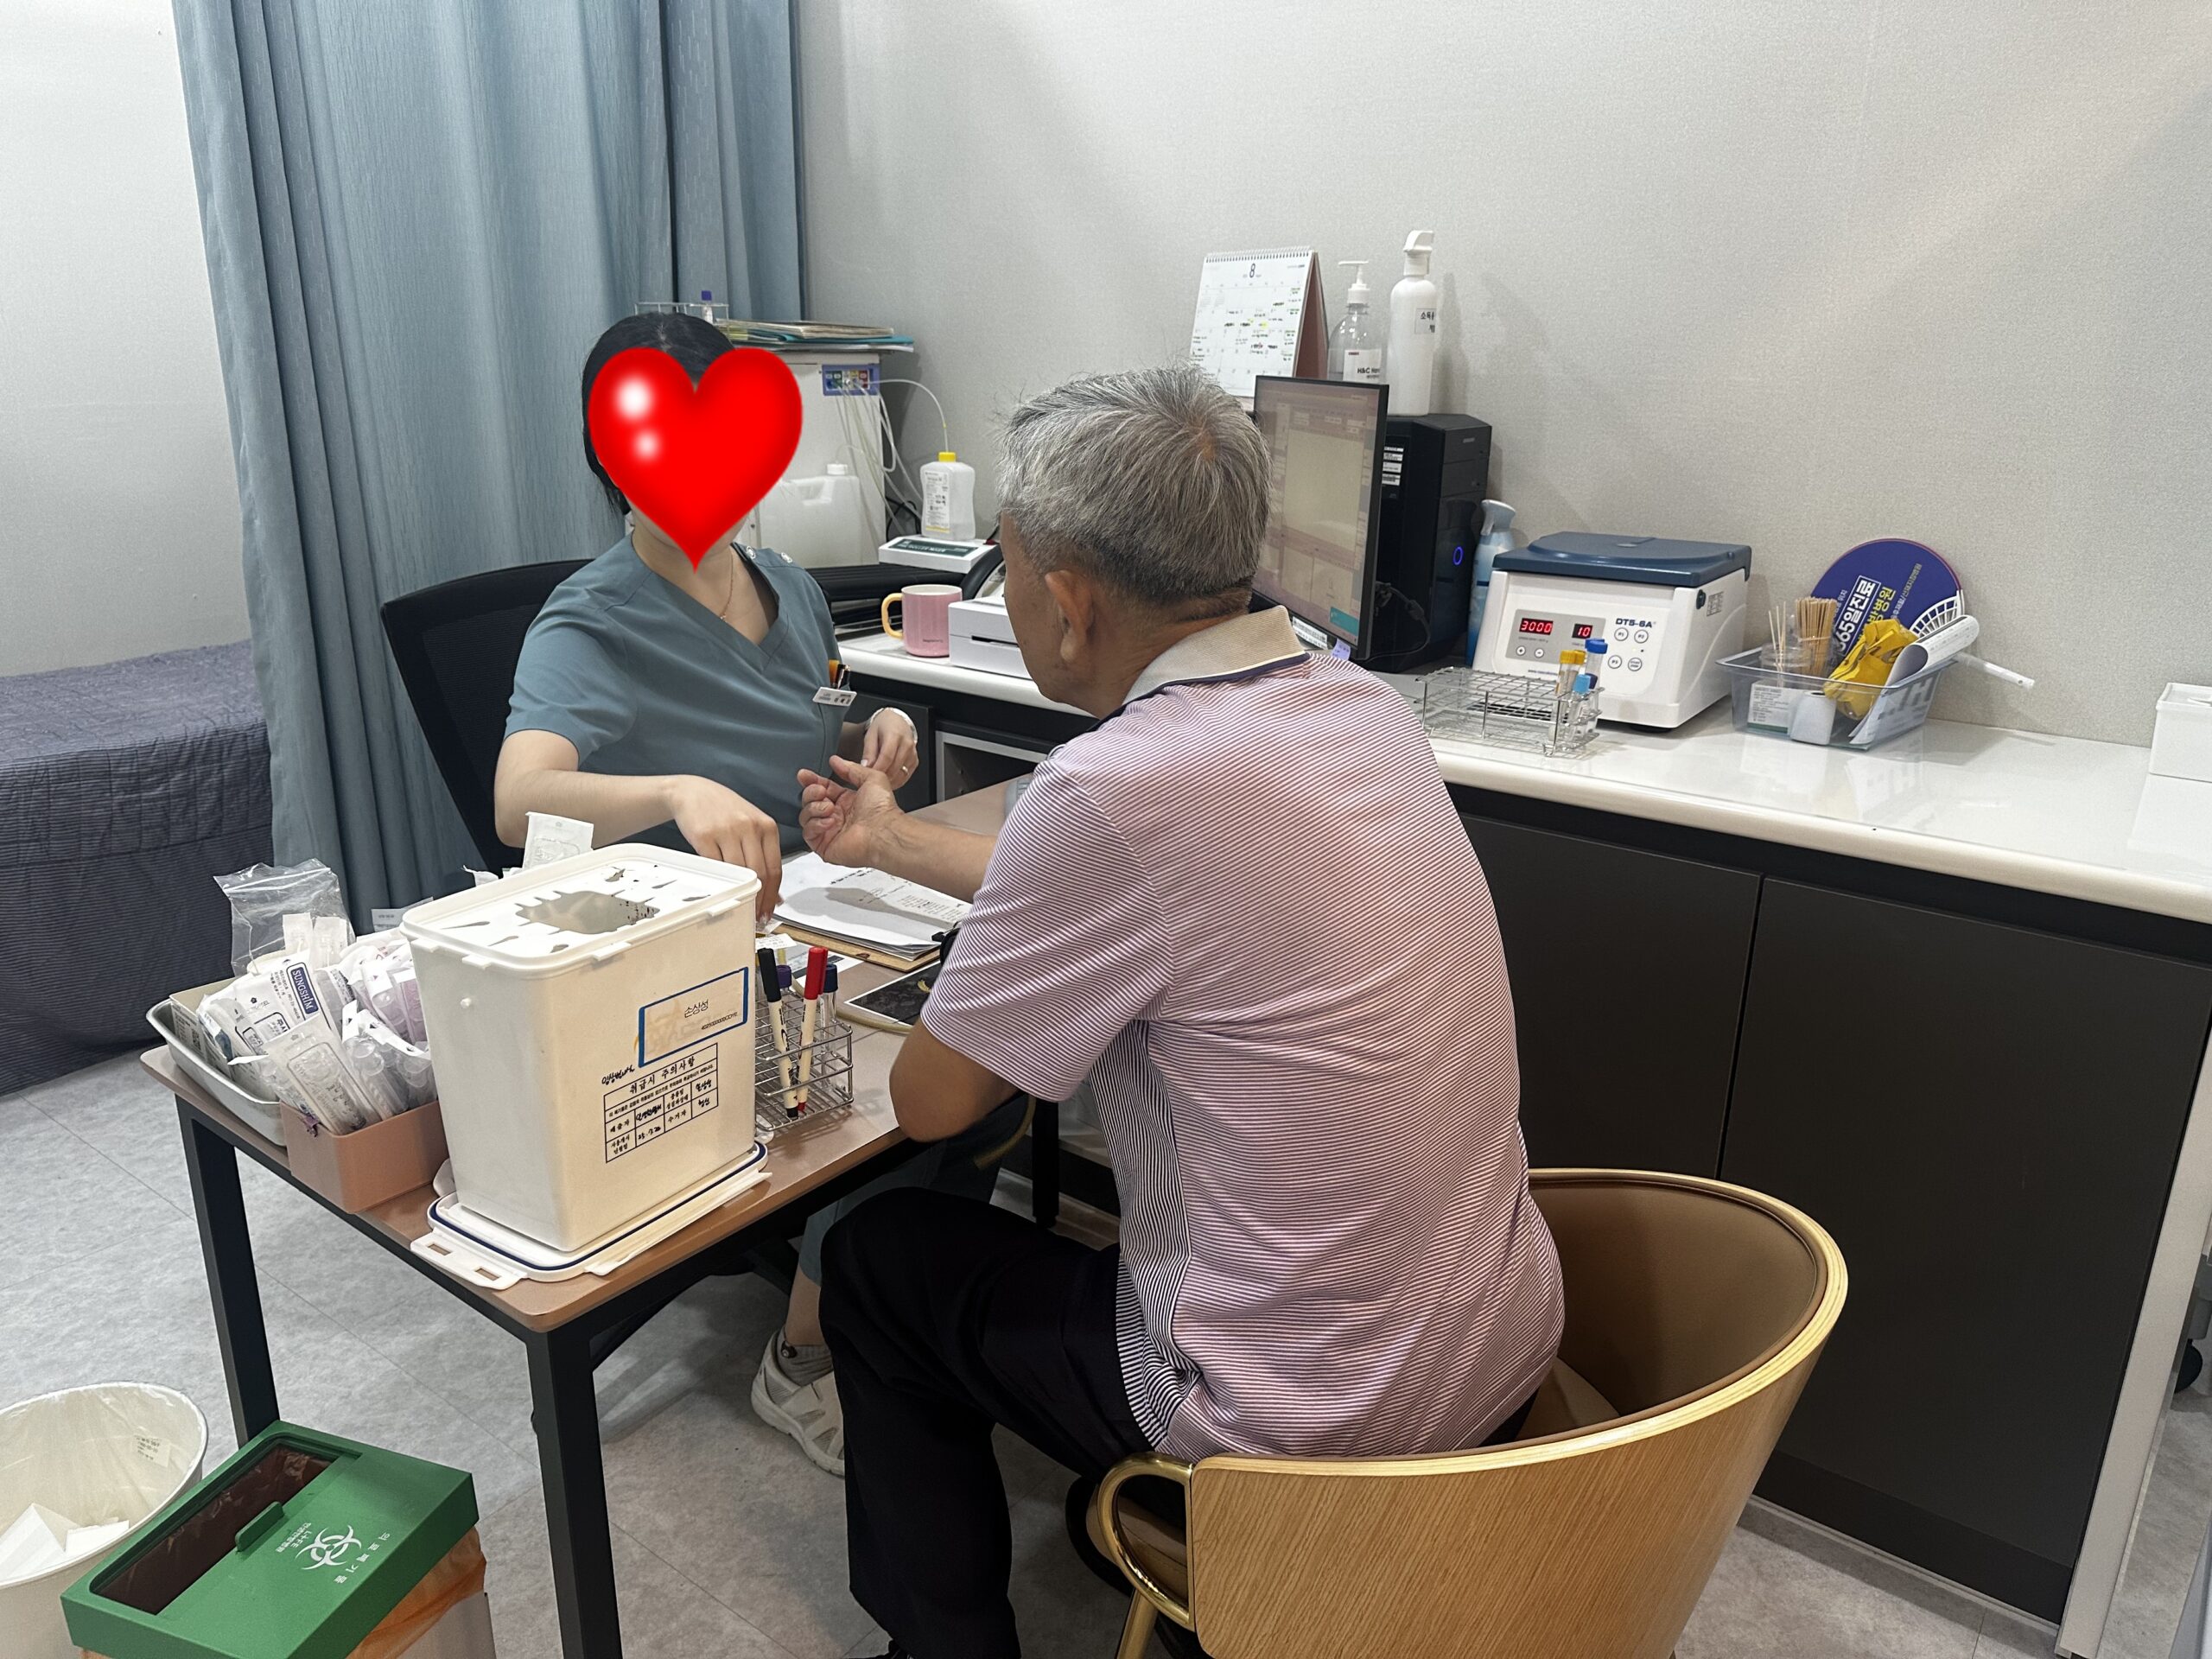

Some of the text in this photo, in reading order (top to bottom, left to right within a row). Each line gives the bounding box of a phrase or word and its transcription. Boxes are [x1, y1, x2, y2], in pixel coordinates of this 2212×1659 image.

[1249, 263, 1256, 279] 8
[1520, 620, 1592, 638] 3000 10
[290, 968, 315, 1011] SUNGSHIM
[629, 1057, 695, 1095] 취급시 주의사항
